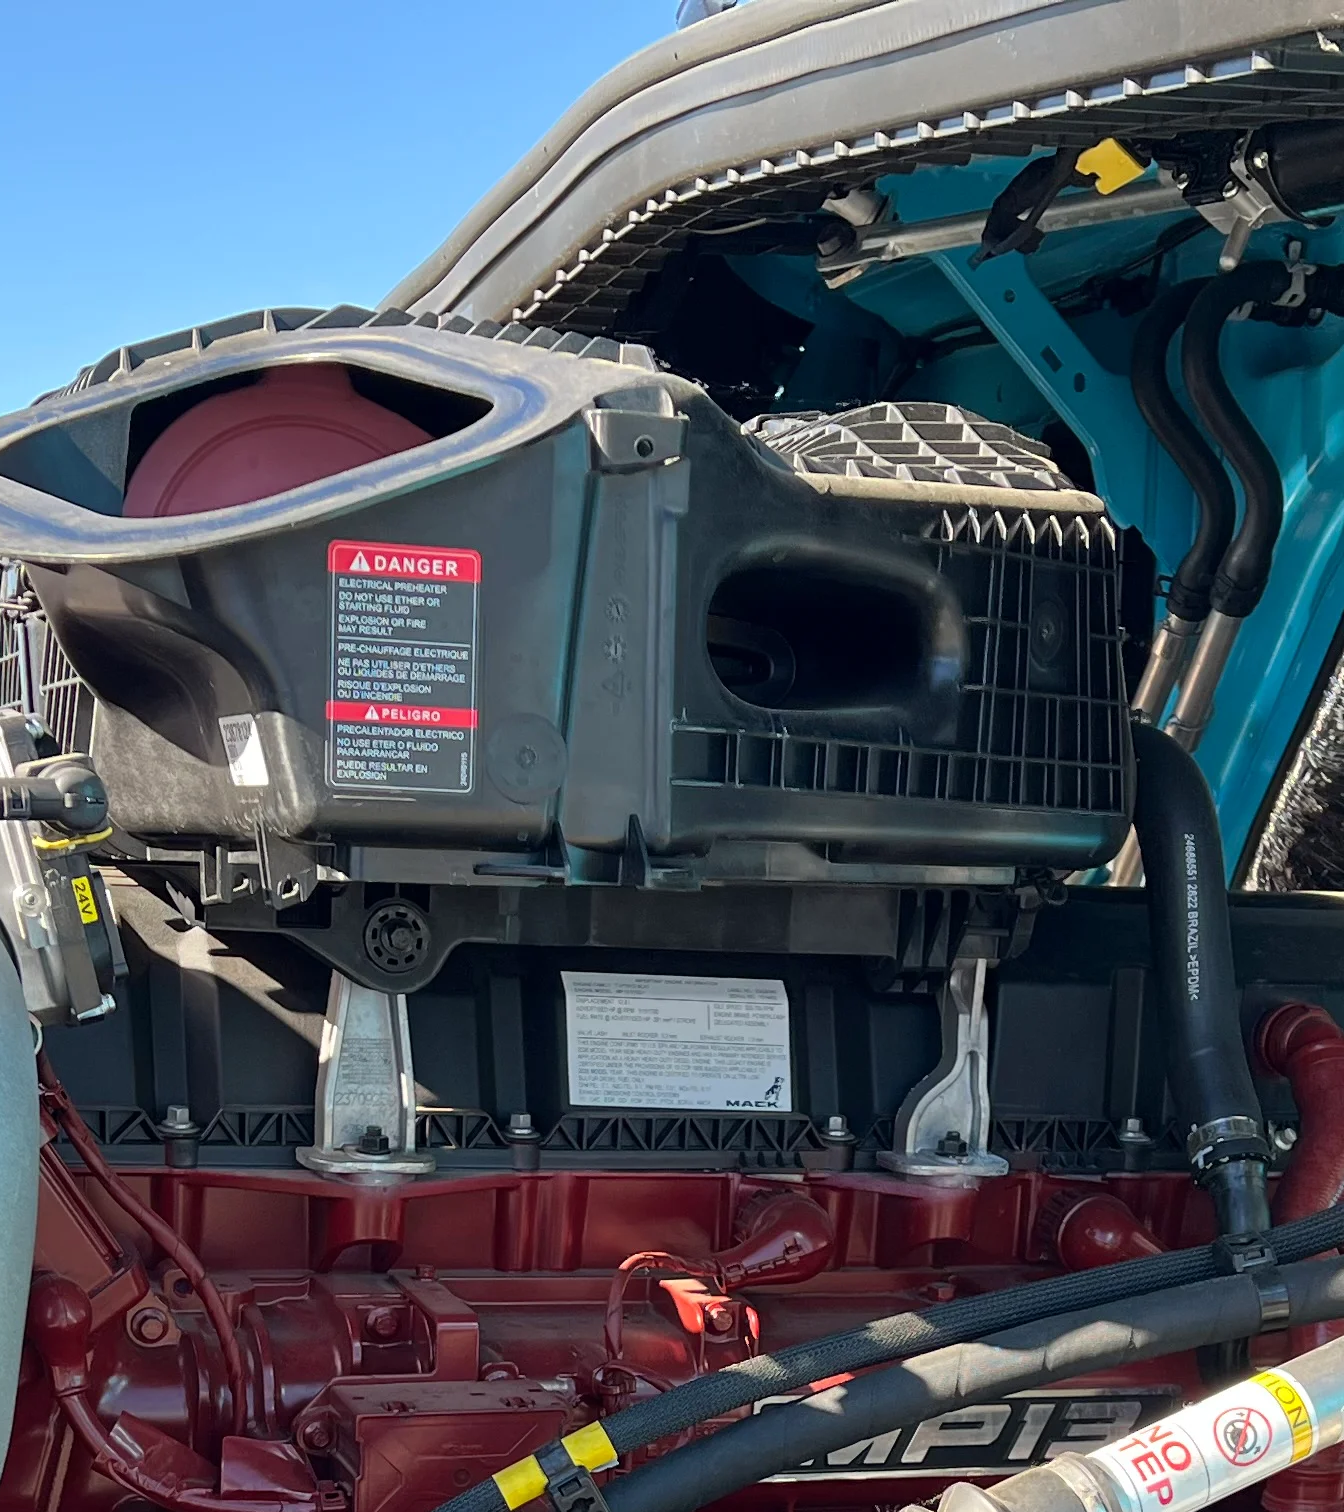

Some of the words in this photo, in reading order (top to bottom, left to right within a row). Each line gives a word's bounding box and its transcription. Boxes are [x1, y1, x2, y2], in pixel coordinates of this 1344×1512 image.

[374, 556, 458, 576] DANGER
[339, 578, 393, 591] ELECTRICAL
[395, 582, 447, 594] PREHEATER
[339, 591, 352, 600] DO
[354, 592, 373, 601] NOT
[376, 593, 393, 603] USE
[395, 595, 424, 606] ETHER
[427, 598, 440, 607] OR
[339, 601, 382, 612] STARTING
[384, 605, 409, 615] FLUID
[338, 614, 389, 626] EXPLOSION
[391, 617, 404, 627] OR
[407, 619, 426, 629] FIRE
[338, 624, 356, 633] MAY
[359, 625, 393, 636] RESULT
[338, 643, 412, 656] PRE-CHAUFFAGE
[338, 658, 350, 666] NE
[353, 659, 369, 668] PAS
[371, 660, 410, 670] UTILISER
[338, 667, 351, 675] OU
[396, 671, 408, 679] DE
[338, 680, 371, 690] RISQUE
[337, 690, 351, 699] OU
[382, 708, 440, 722] PELIGRO
[337, 724, 413, 737] PRECALENTADOR
[337, 738, 350, 747] NO
[353, 739, 370, 748] USE
[373, 740, 395, 749] ETER
[407, 742, 438, 752] FLUIDO
[337, 747, 360, 756] PARA
[361, 748, 409, 759] ARRANCAR
[337, 760, 366, 770] PUEDE
[369, 761, 413, 772] RESULTAR
[416, 764, 427, 774] EN
[337, 769, 386, 780] EXPLOSION
[75, 883, 93, 914] 24V
[1187, 912, 1198, 953] BRAZIL
[726, 1100, 778, 1108] MACK
[1141, 1425, 1192, 1471] NO
[1113, 1438, 1173, 1506] TEP
